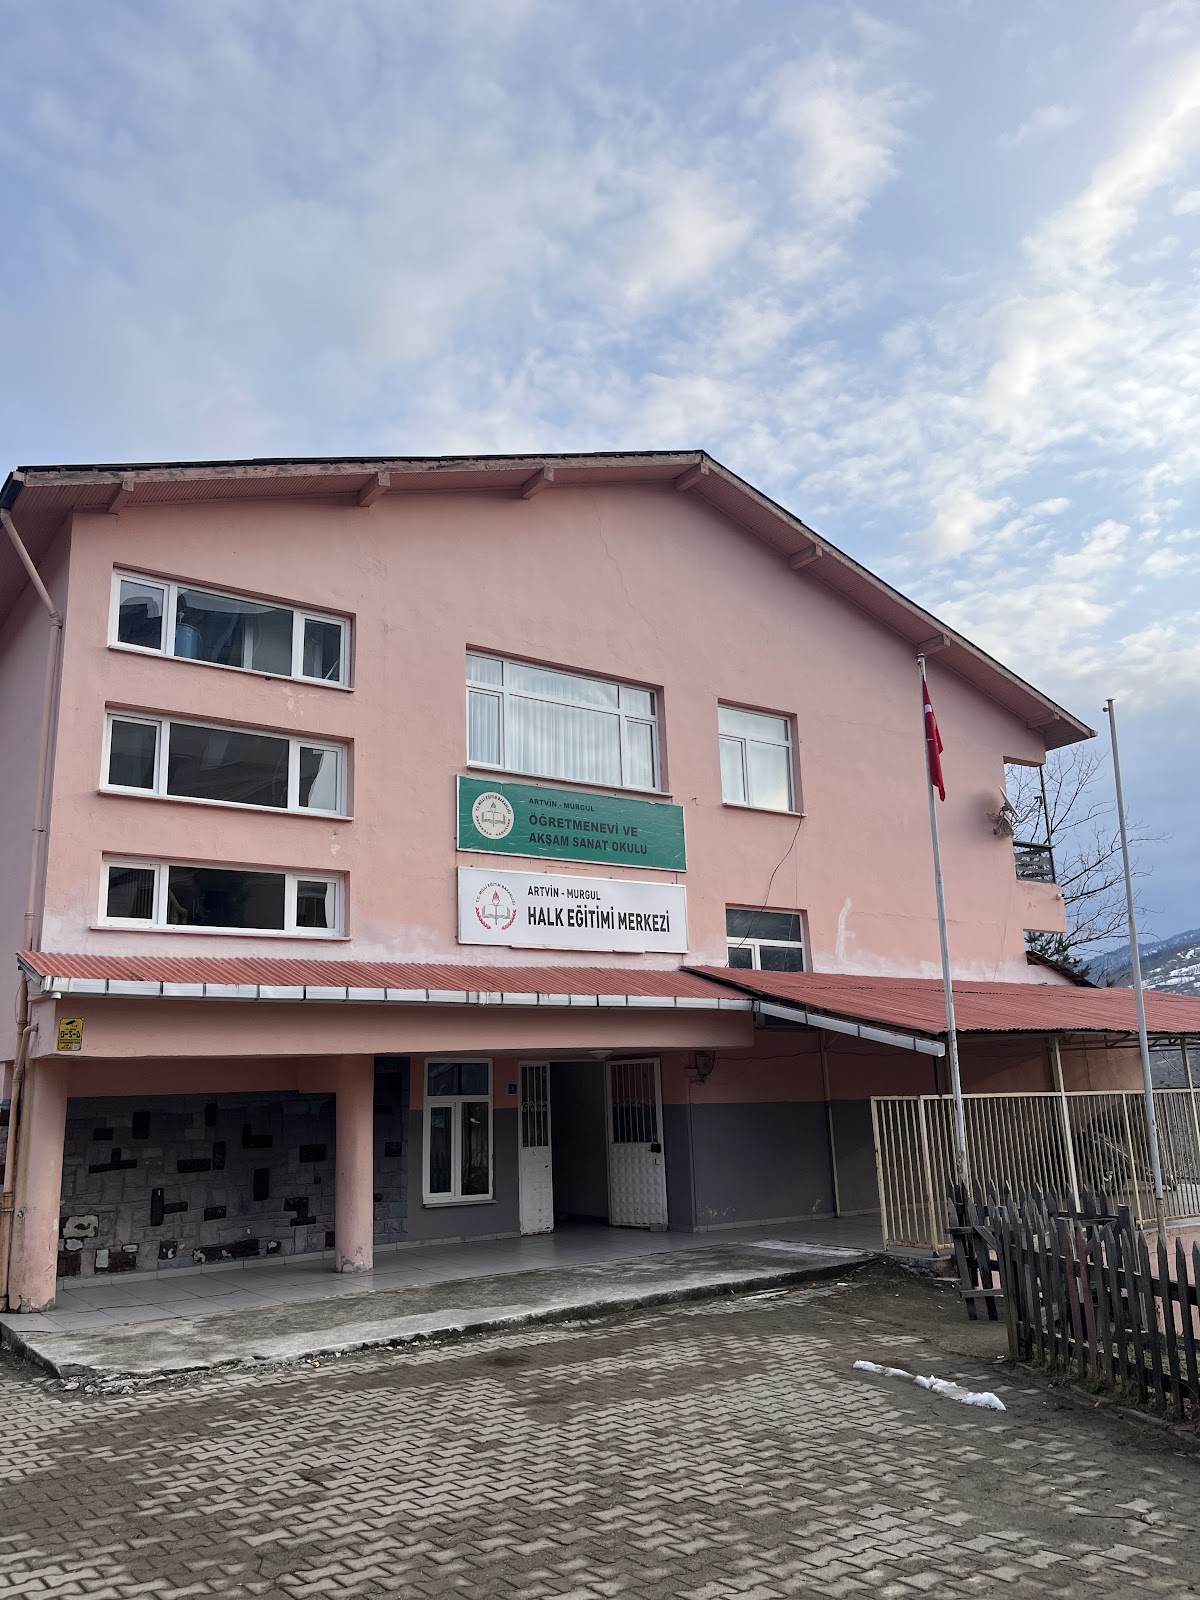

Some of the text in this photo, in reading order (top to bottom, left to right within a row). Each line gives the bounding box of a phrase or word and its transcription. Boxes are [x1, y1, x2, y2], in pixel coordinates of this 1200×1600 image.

[529, 798, 557, 807] ARTVİN
[563, 802, 595, 812] MURGUL
[528, 812, 638, 837] ÖĞRETMENEVİ VE
[528, 832, 648, 854] AKŞAM SANAT OKULU
[527, 884, 559, 898] ARTVİN
[566, 888, 601, 901] MURGUL
[527, 904, 670, 933] HALK EĞİTİMİ MERKEZİ
